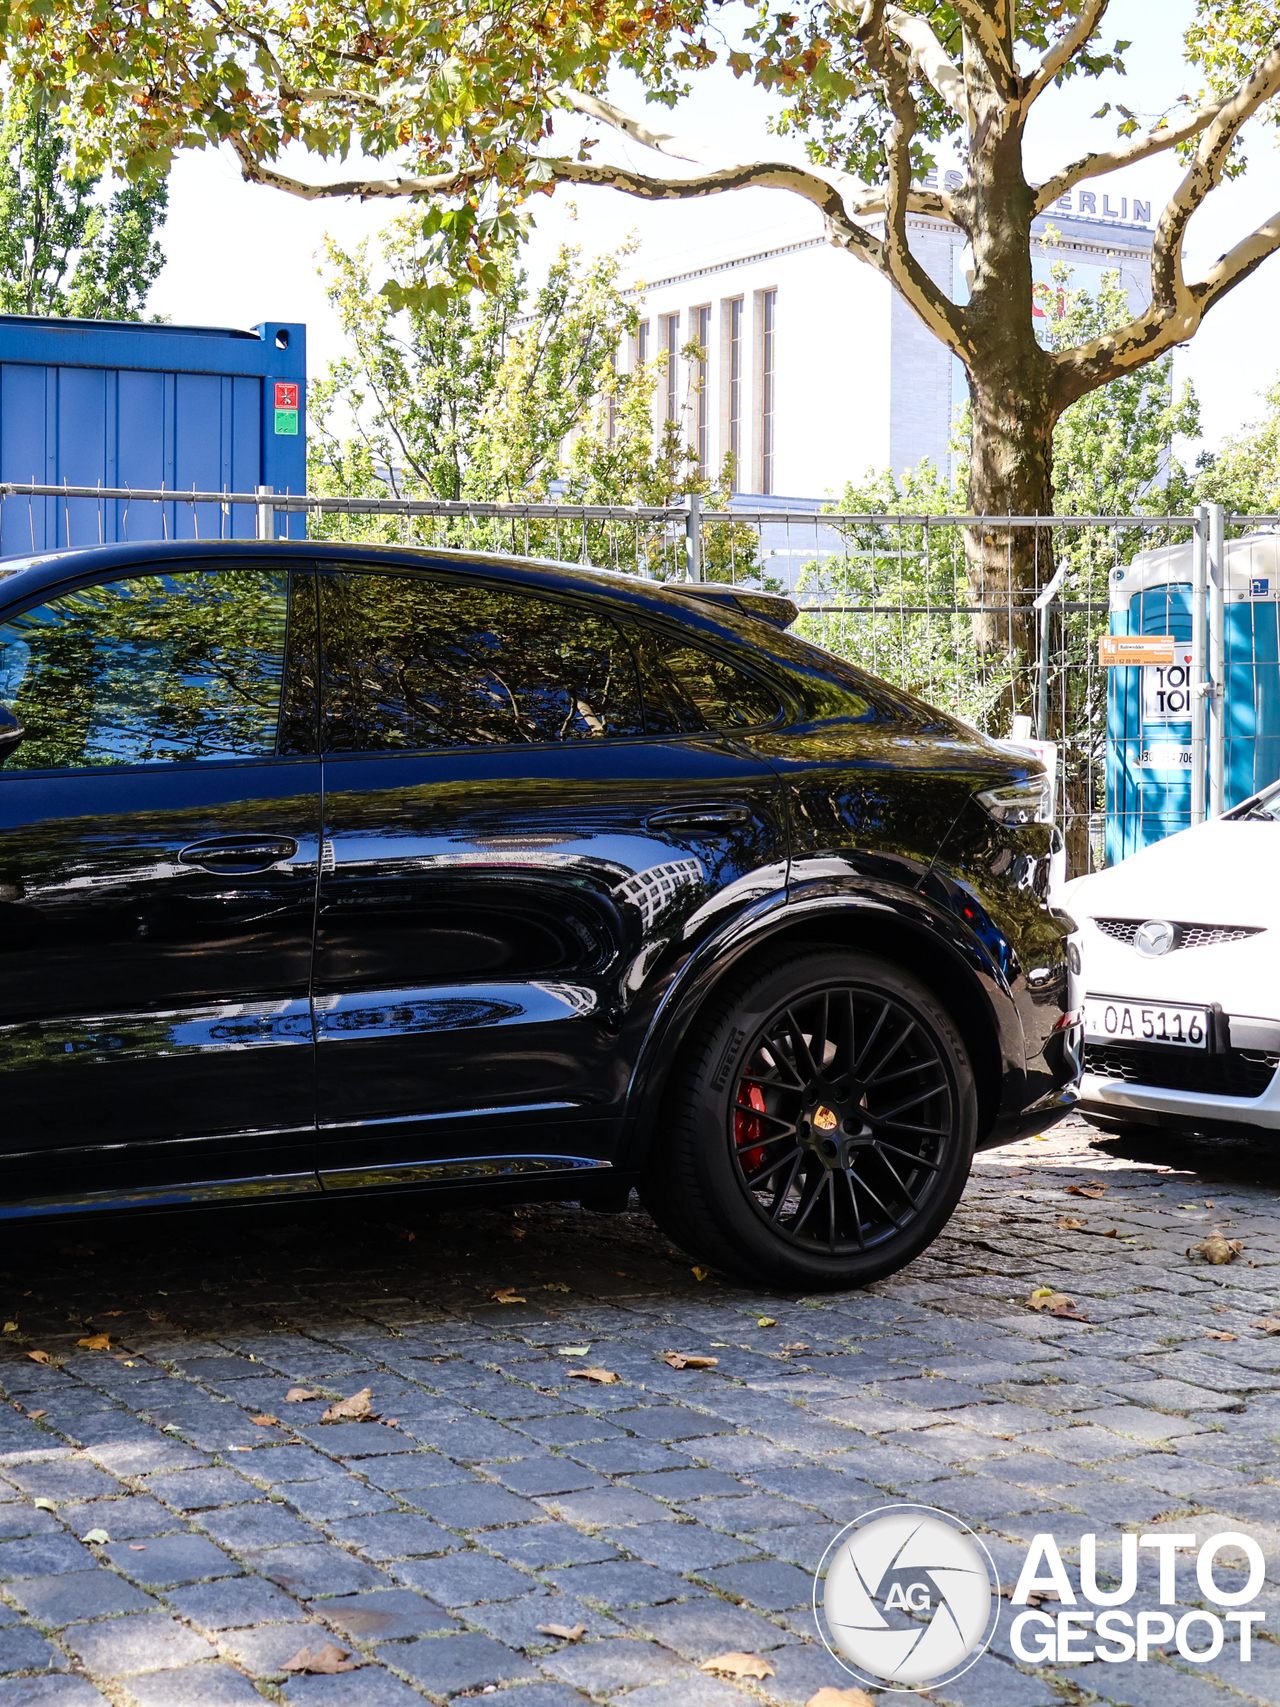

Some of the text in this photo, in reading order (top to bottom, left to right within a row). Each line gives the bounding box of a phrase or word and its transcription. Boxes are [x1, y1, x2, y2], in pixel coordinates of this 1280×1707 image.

[1055, 186, 1151, 222] ERLIN
[1156, 666, 1190, 688] TOI
[1156, 690, 1190, 712] TOI
[1141, 1010, 1204, 1044] 5116
[709, 1027, 746, 1094] PIRELLI
